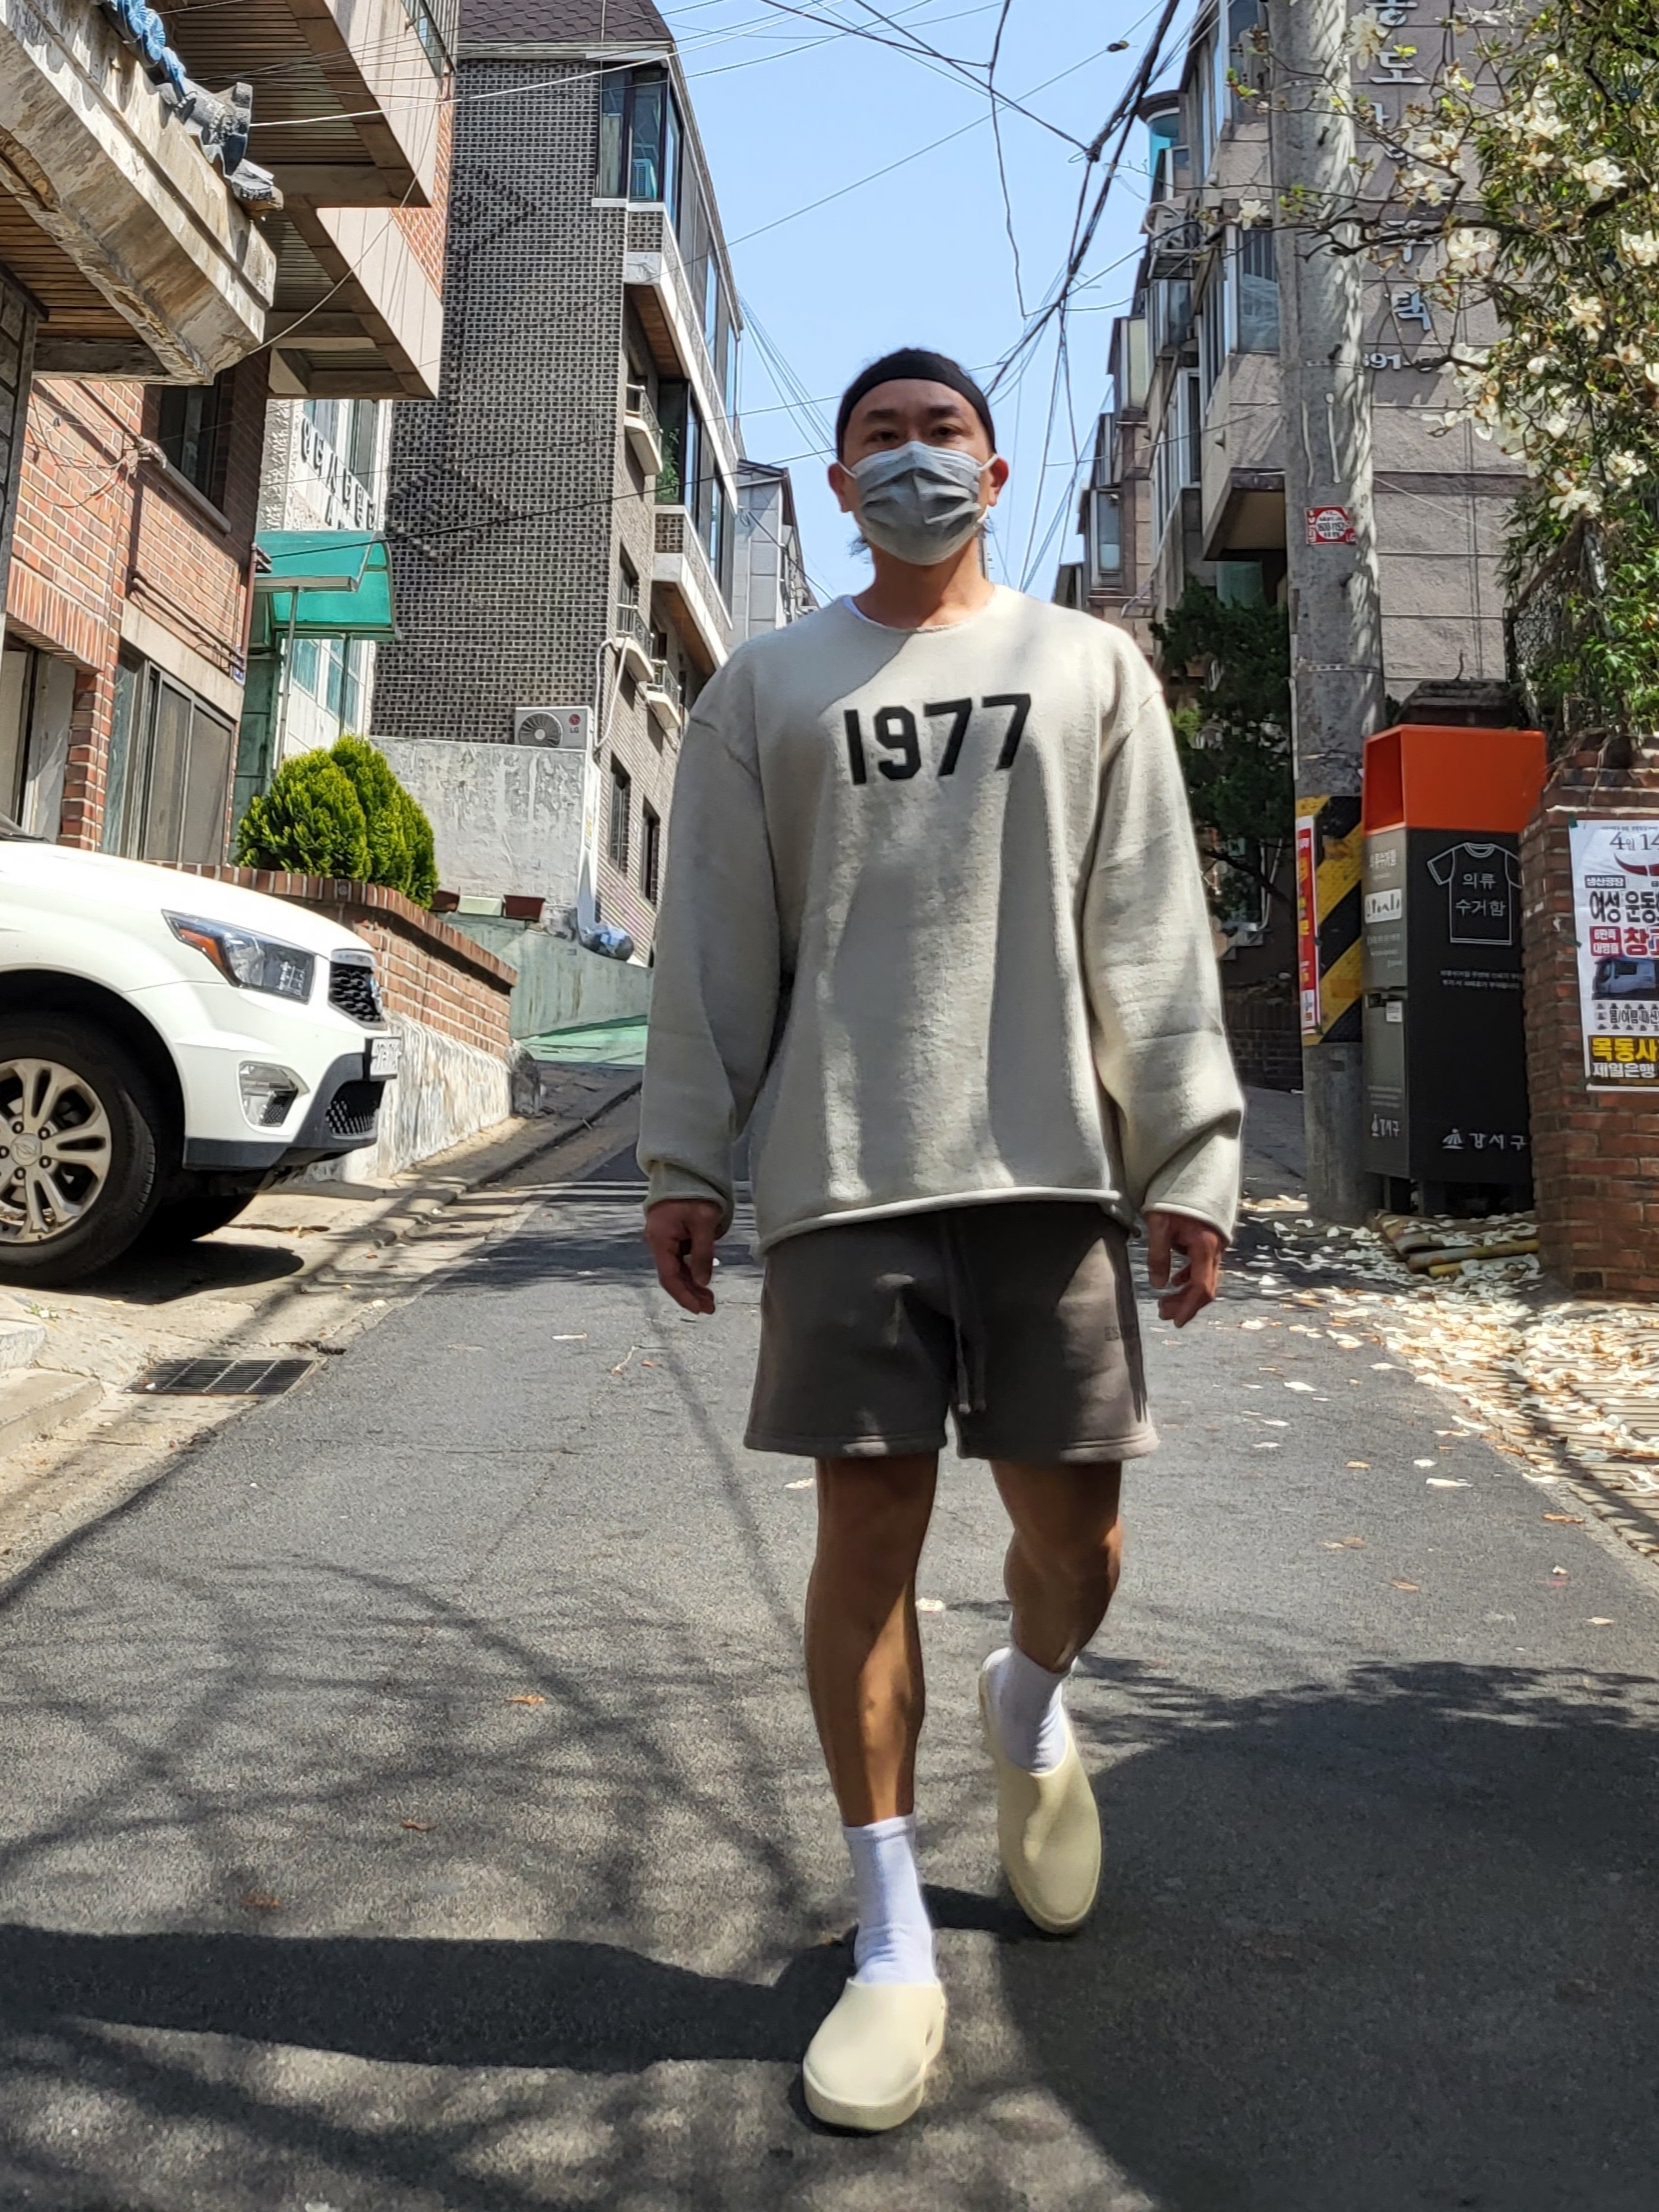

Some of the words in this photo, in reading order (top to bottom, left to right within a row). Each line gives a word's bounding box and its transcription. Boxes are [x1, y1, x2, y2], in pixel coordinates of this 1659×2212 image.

[569, 726, 580, 734] LG
[843, 692, 1032, 786] 1977
[1462, 873, 1497, 890] 의류
[1455, 898, 1507, 917] 수거함
[1589, 890, 1621, 923] 여성
[1625, 890, 1659, 923] 운동
[1591, 1062, 1656, 1079] 제일은행
[1469, 1132, 1528, 1151] 강서구
